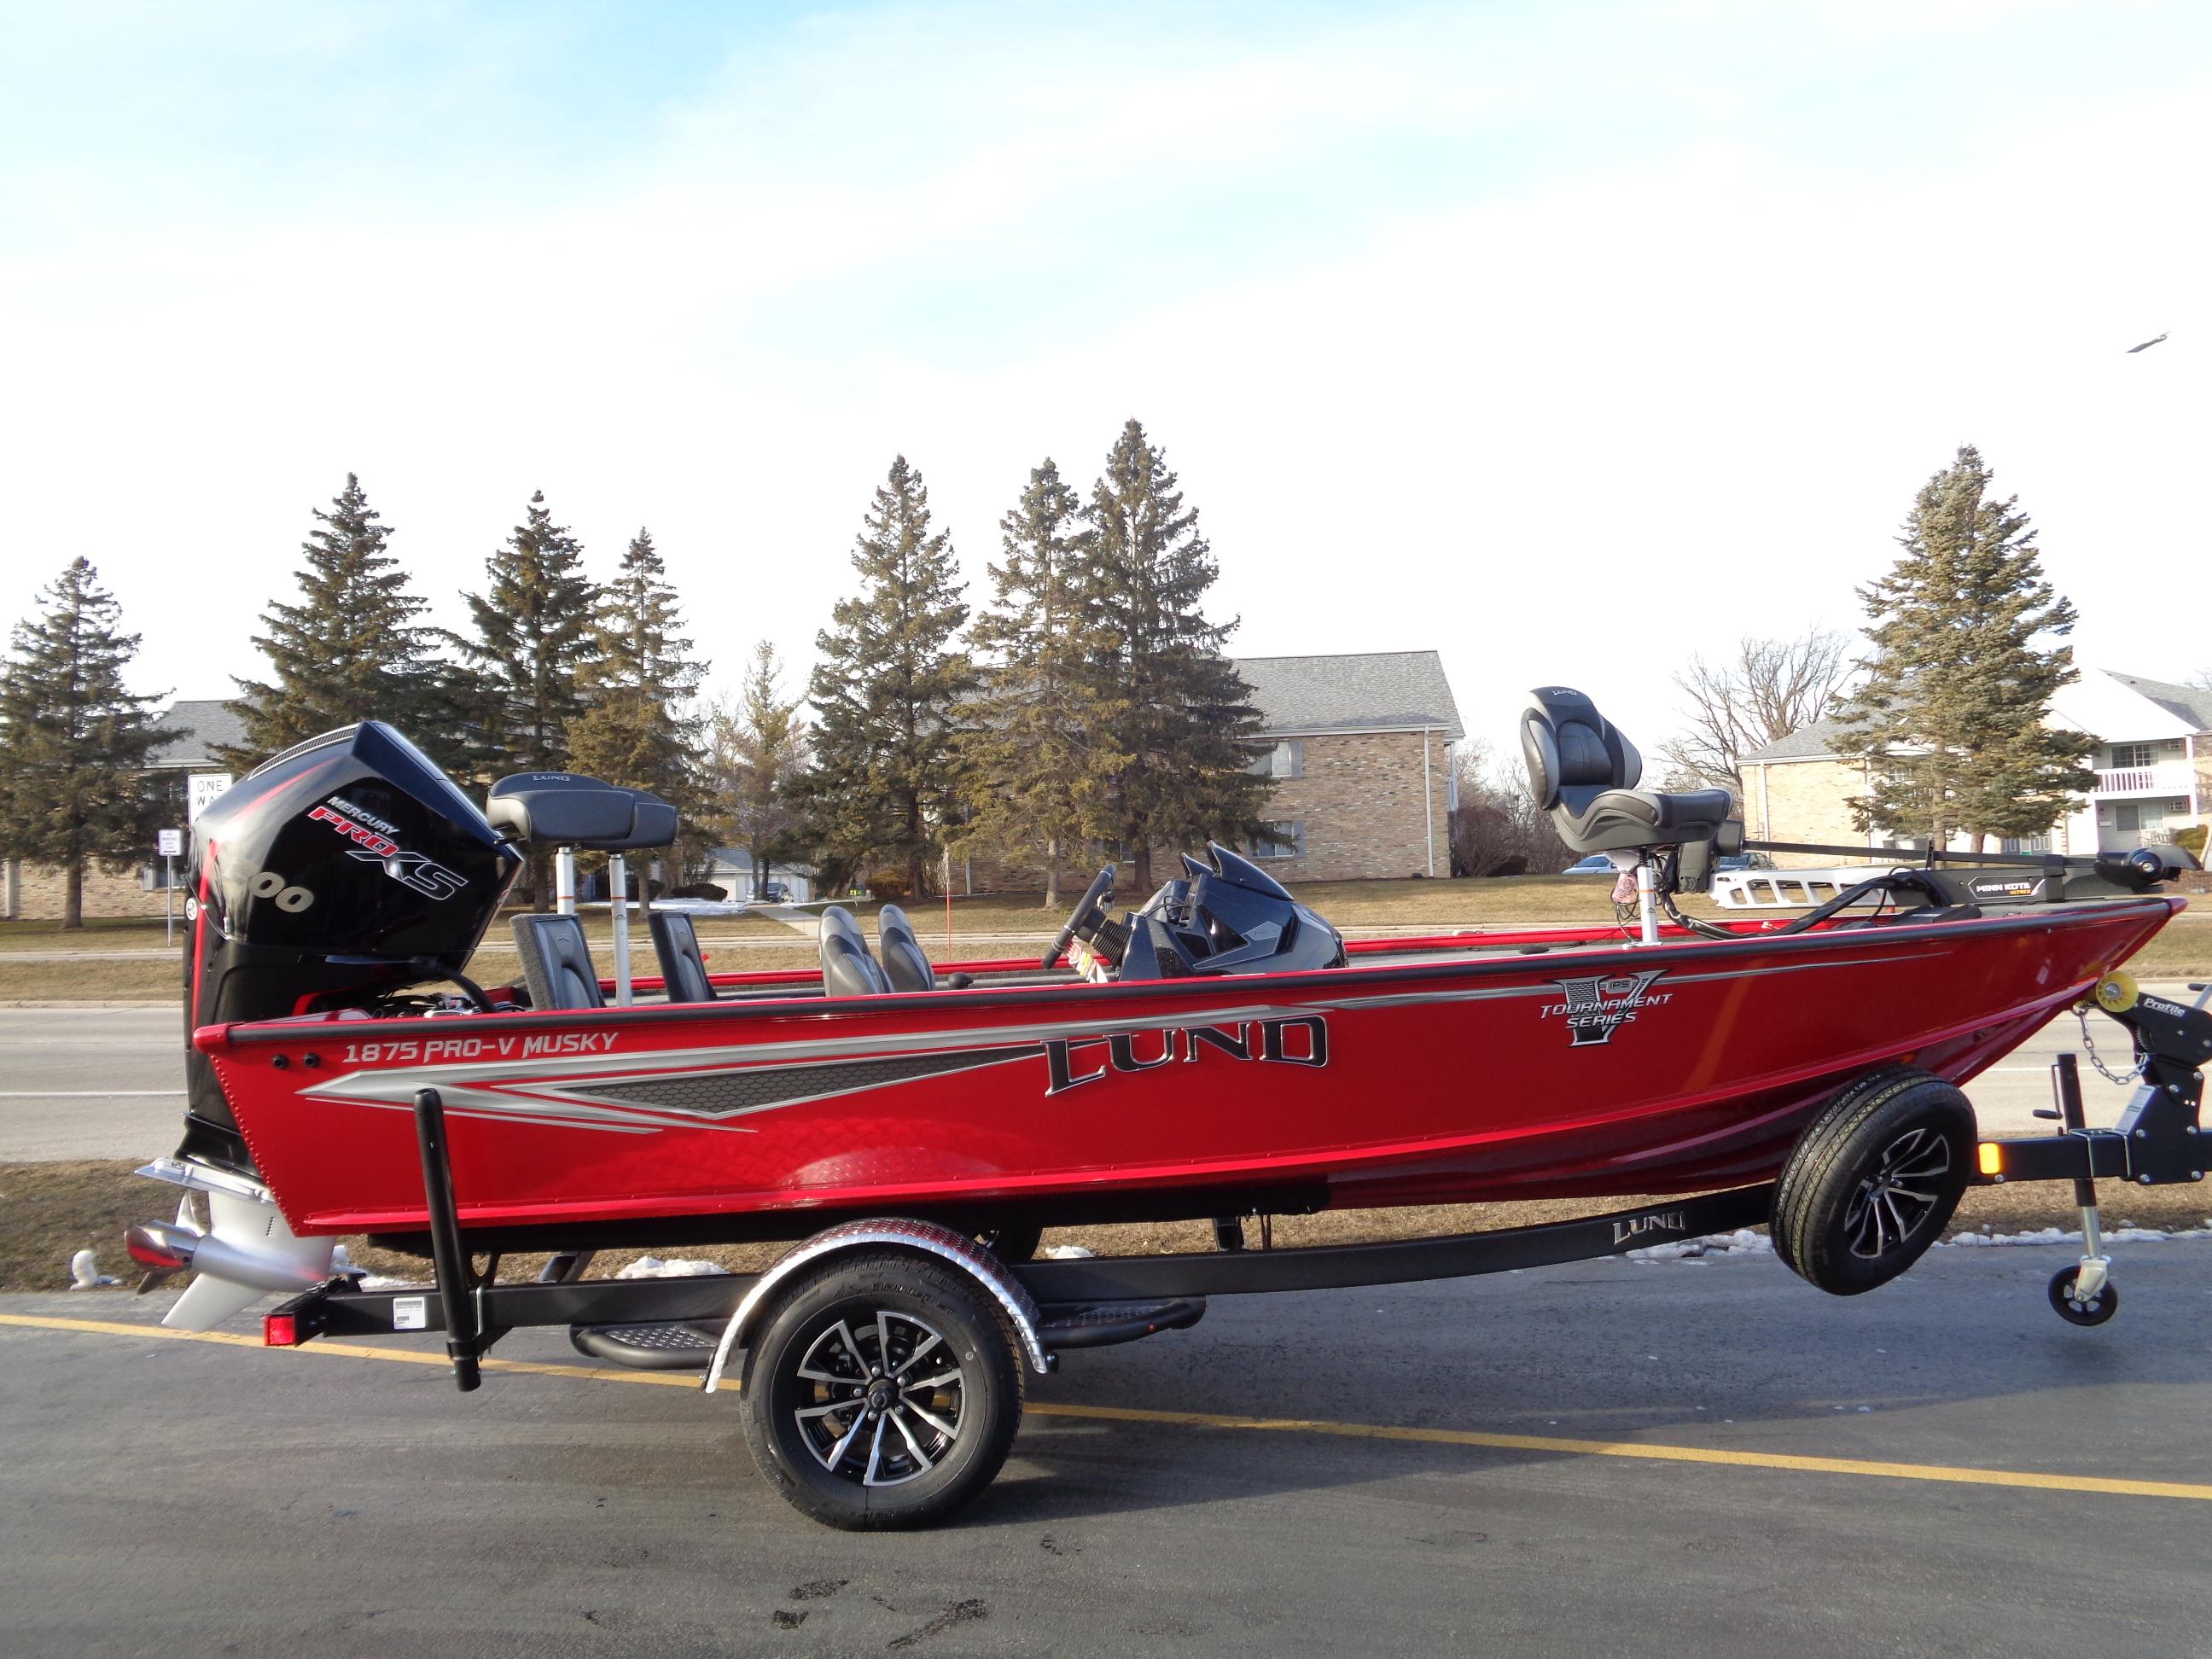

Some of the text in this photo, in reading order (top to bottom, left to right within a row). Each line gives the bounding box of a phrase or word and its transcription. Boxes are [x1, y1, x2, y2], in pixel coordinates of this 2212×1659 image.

[196, 795, 220, 806] WA
[197, 780, 224, 793] ONE
[327, 796, 400, 835] MERCURY
[308, 806, 469, 900] PRO XS
[233, 861, 314, 913] 00
[1976, 882, 2031, 893] MINN KOTA
[1540, 993, 1673, 1019] TOURNAMENT
[1565, 1011, 1638, 1029] SERIES
[2144, 998, 2186, 1016] Profile
[342, 1033, 619, 1063] 1875 PRO-V MUSKY
[1040, 1016, 1329, 1097] LUND
[1613, 1211, 1685, 1245] LUND
